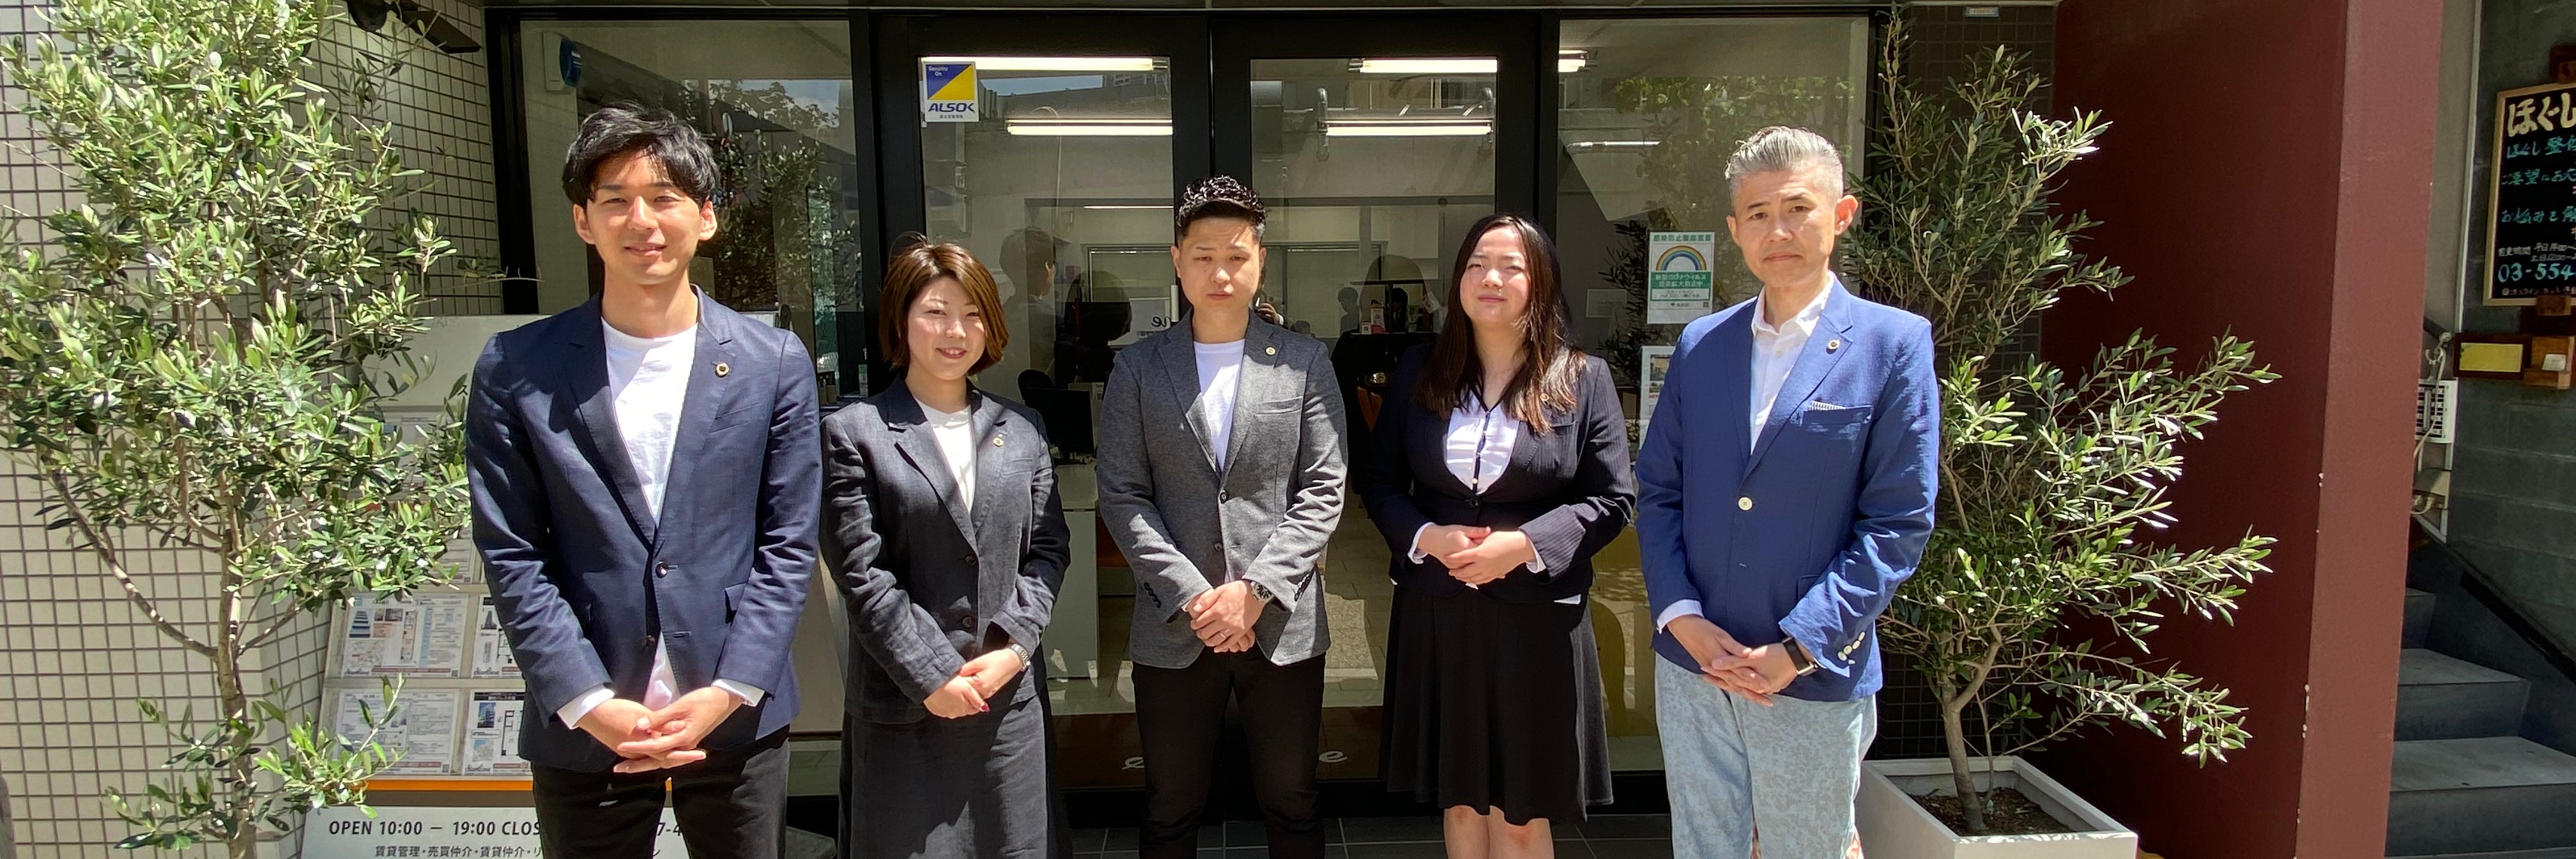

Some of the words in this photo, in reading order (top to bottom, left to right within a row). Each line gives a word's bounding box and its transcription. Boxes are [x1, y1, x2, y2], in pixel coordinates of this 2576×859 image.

[928, 103, 976, 113] ALSOK
[328, 821, 372, 835] OPEN
[379, 821, 423, 835] 10:00
[452, 821, 496, 835] 19:00
